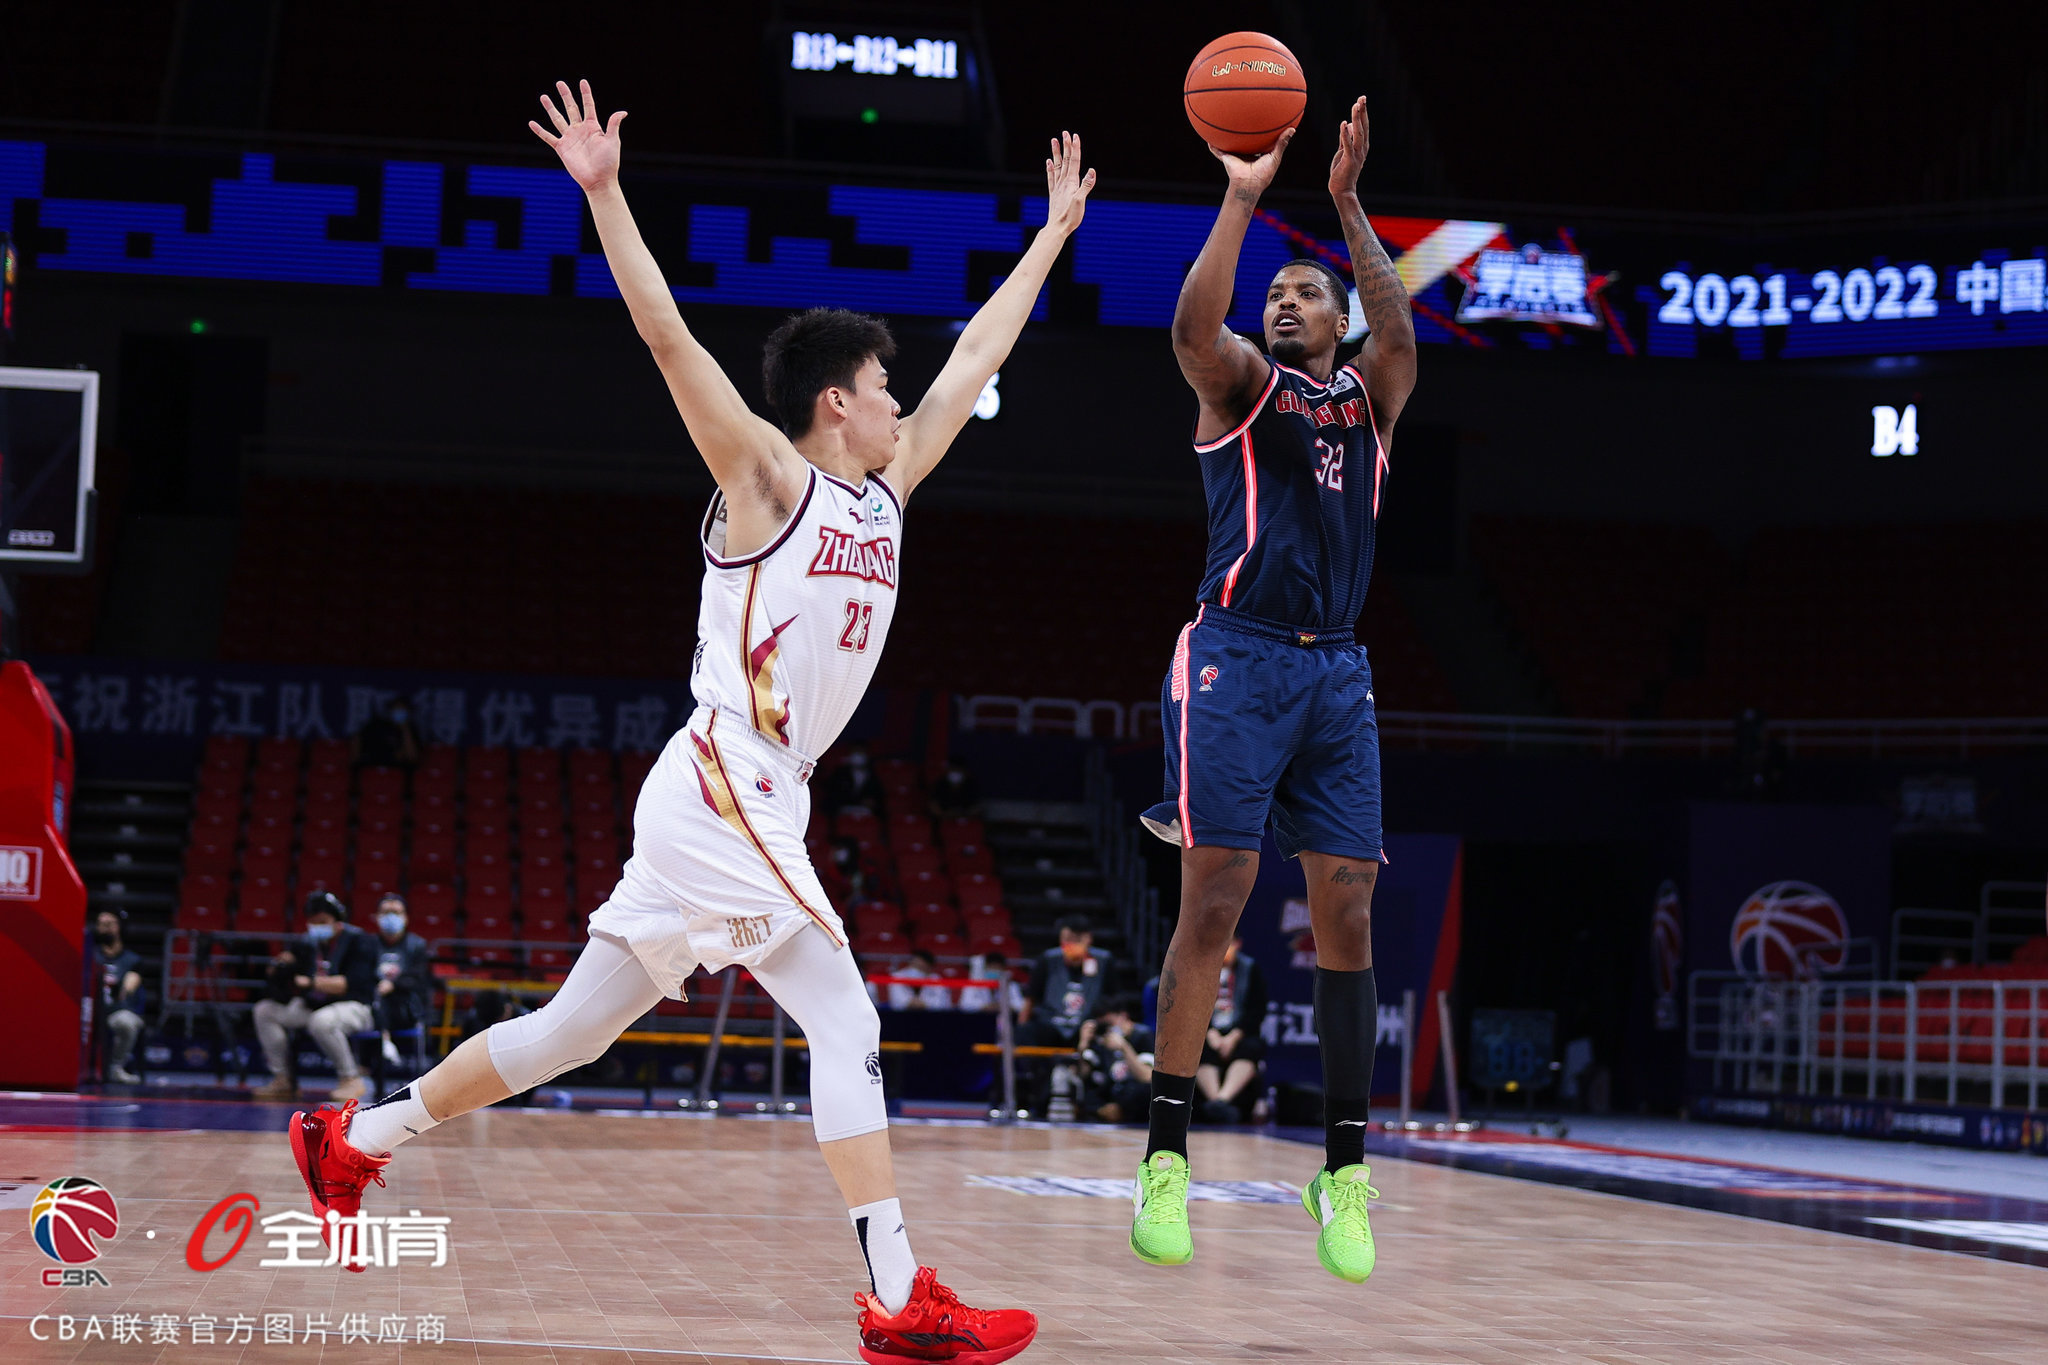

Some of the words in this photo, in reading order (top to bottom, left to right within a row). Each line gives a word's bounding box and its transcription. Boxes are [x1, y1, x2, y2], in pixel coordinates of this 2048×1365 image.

[1658, 264, 1939, 327] 2021-2022
[1955, 258, 2048, 316] 中国
[1275, 390, 1366, 429] GUGONG
[1871, 403, 1920, 457] B4
[1314, 437, 1345, 492] 32
[838, 597, 874, 654] 23
